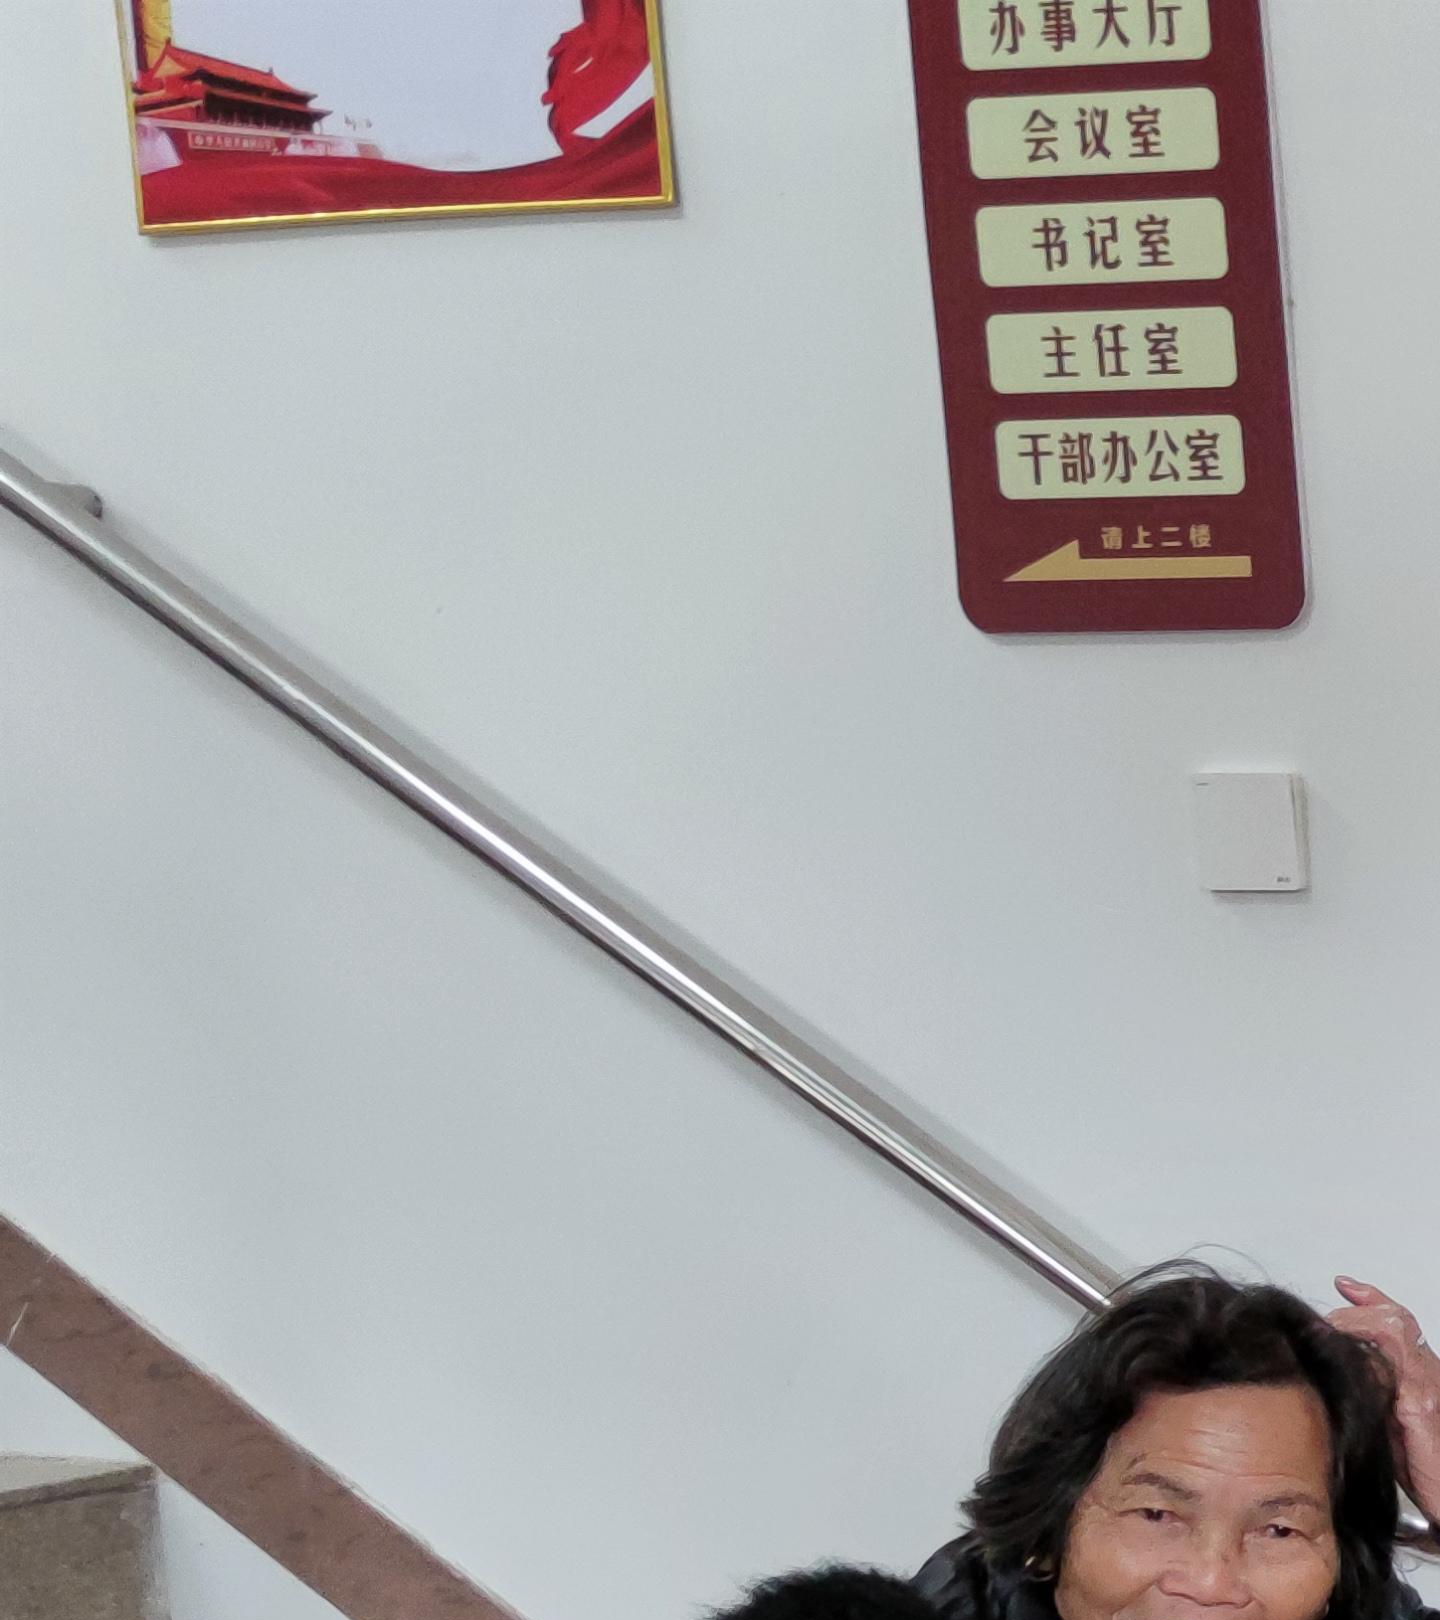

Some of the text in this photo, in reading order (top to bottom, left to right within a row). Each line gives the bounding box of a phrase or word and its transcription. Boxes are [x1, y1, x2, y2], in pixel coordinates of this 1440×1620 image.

[989, 0, 1182, 55] 办事大厅
[1022, 104, 1165, 163] 会议室
[1032, 213, 1174, 271] 书记室
[1040, 322, 1183, 377] 主任室
[1017, 429, 1223, 485] 干部办公室
[1101, 524, 1211, 550] 请上二楼
